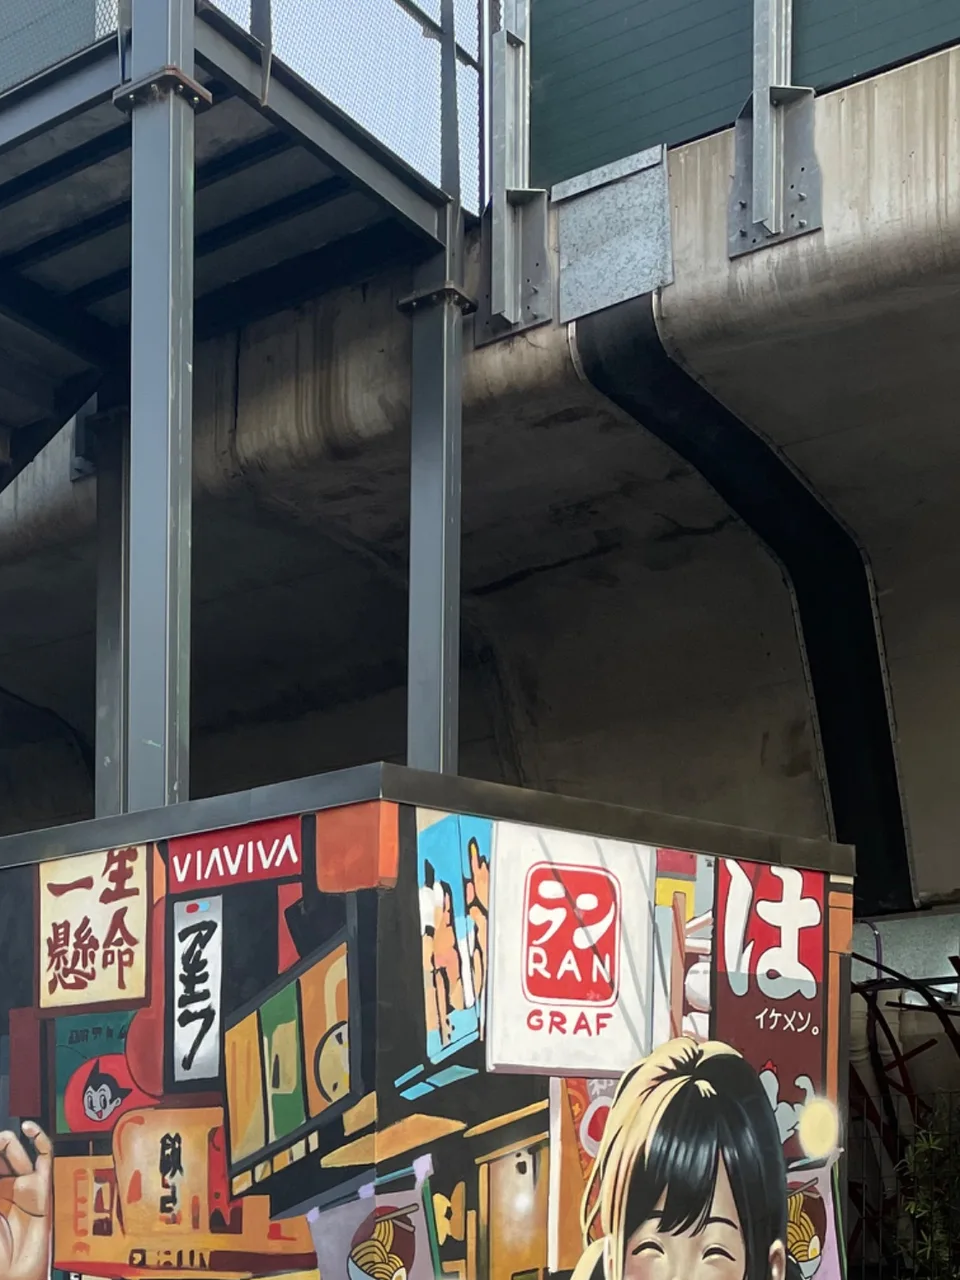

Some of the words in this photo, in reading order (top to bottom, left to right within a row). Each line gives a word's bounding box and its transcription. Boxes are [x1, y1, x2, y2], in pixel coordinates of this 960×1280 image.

[45, 847, 140, 905] 一生
[172, 833, 299, 883] VIAVIVA
[527, 879, 616, 950] ラン
[719, 857, 823, 1000] は
[527, 950, 612, 985] RAN
[526, 1008, 614, 1037] GRAF
